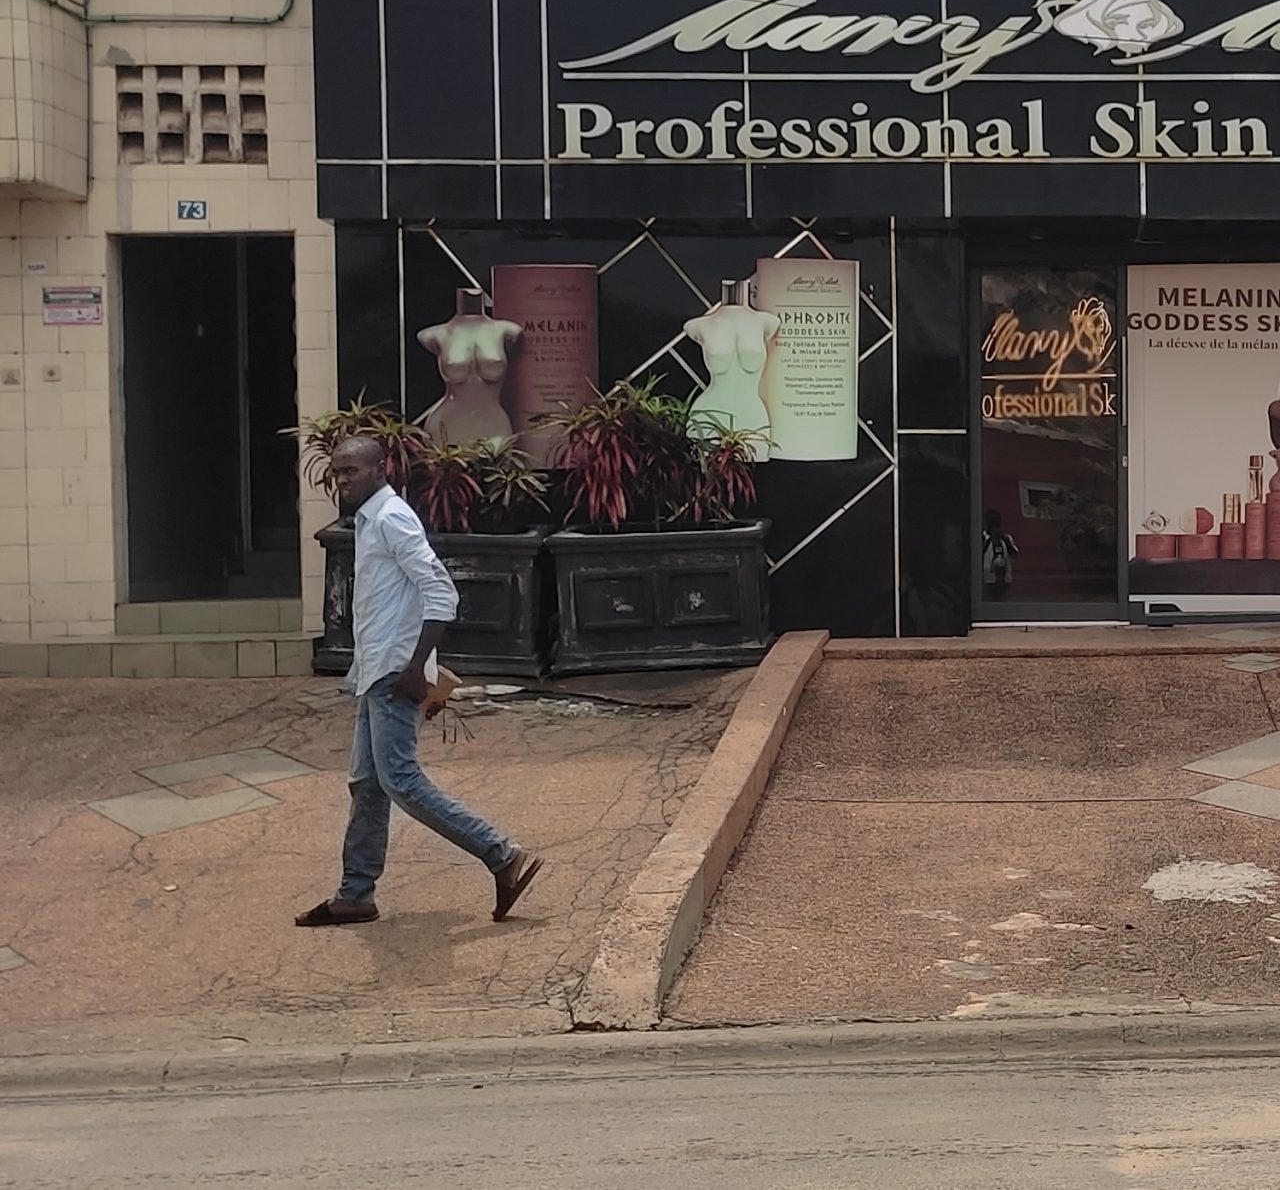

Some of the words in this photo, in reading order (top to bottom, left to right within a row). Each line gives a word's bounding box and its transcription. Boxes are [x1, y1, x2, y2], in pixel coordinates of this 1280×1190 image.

[556, 99, 1051, 160] Professional
[1089, 99, 1274, 159] Skin
[180, 201, 205, 219] 73
[523, 320, 588, 333] MELANIN
[1127, 312, 1249, 332] GODDESS
[781, 328, 826, 336] GODDESS
[828, 328, 847, 336] SKIN
[818, 340, 829, 348] for
[1148, 339, 1163, 349] La
[1209, 338, 1225, 350] de
[1227, 338, 1239, 350] la
[1089, 383, 1117, 416] Sk
